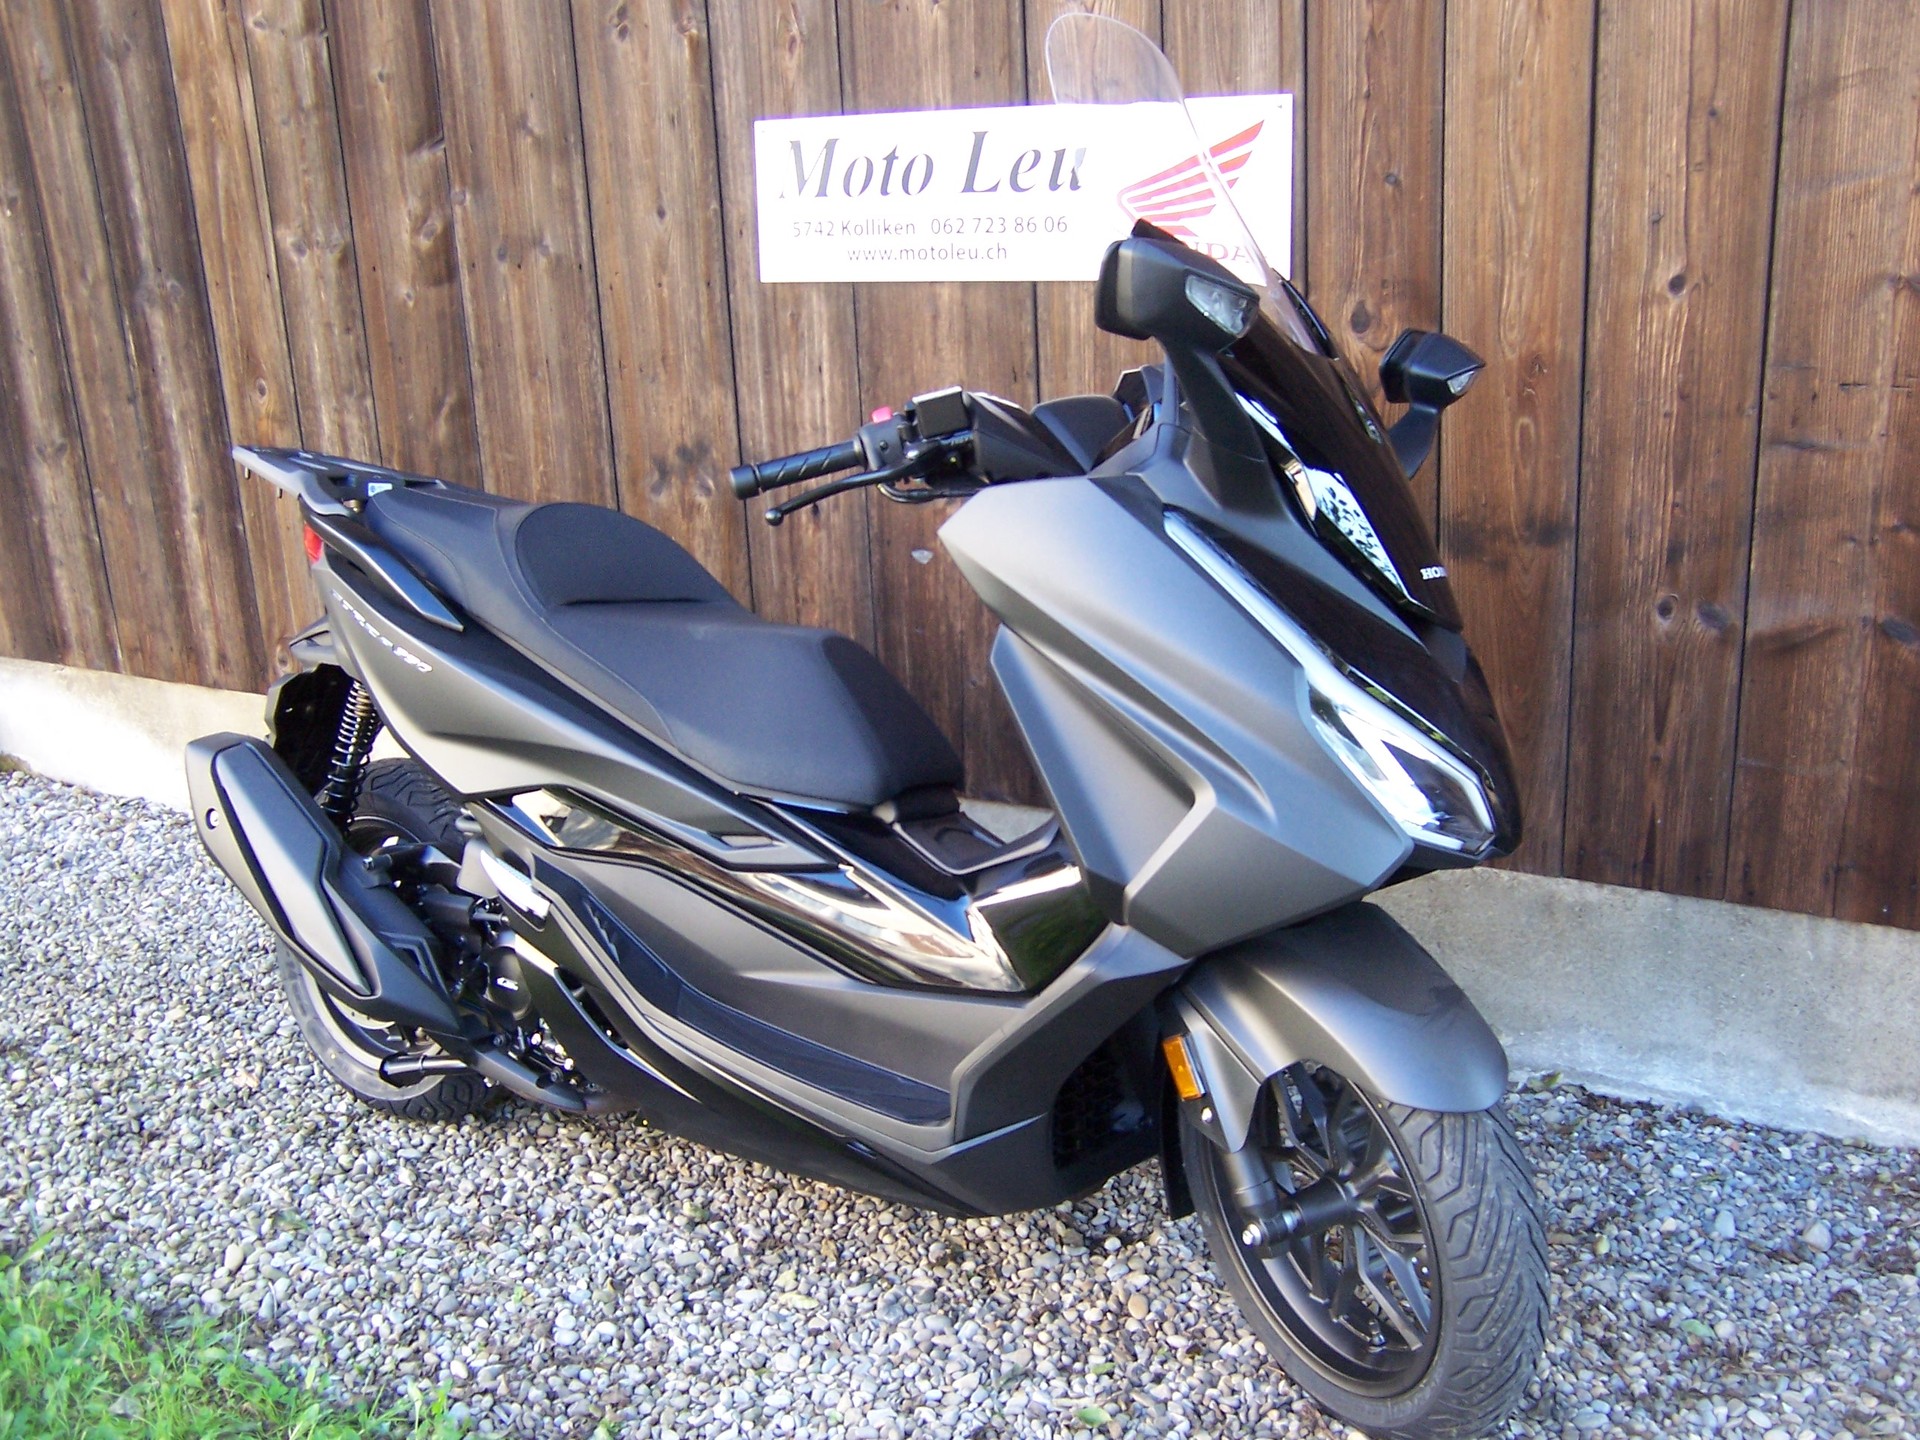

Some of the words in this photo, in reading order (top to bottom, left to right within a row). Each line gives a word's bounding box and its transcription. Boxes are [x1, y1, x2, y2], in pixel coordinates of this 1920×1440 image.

[779, 138, 934, 199] Moto
[960, 130, 1087, 193] Leu
[793, 221, 835, 238] 5742
[930, 217, 965, 235] 062
[972, 217, 1007, 234] 723
[1014, 216, 1038, 233] 86
[1044, 215, 1068, 233] 06
[847, 242, 1007, 261] www.motoleu.ch
